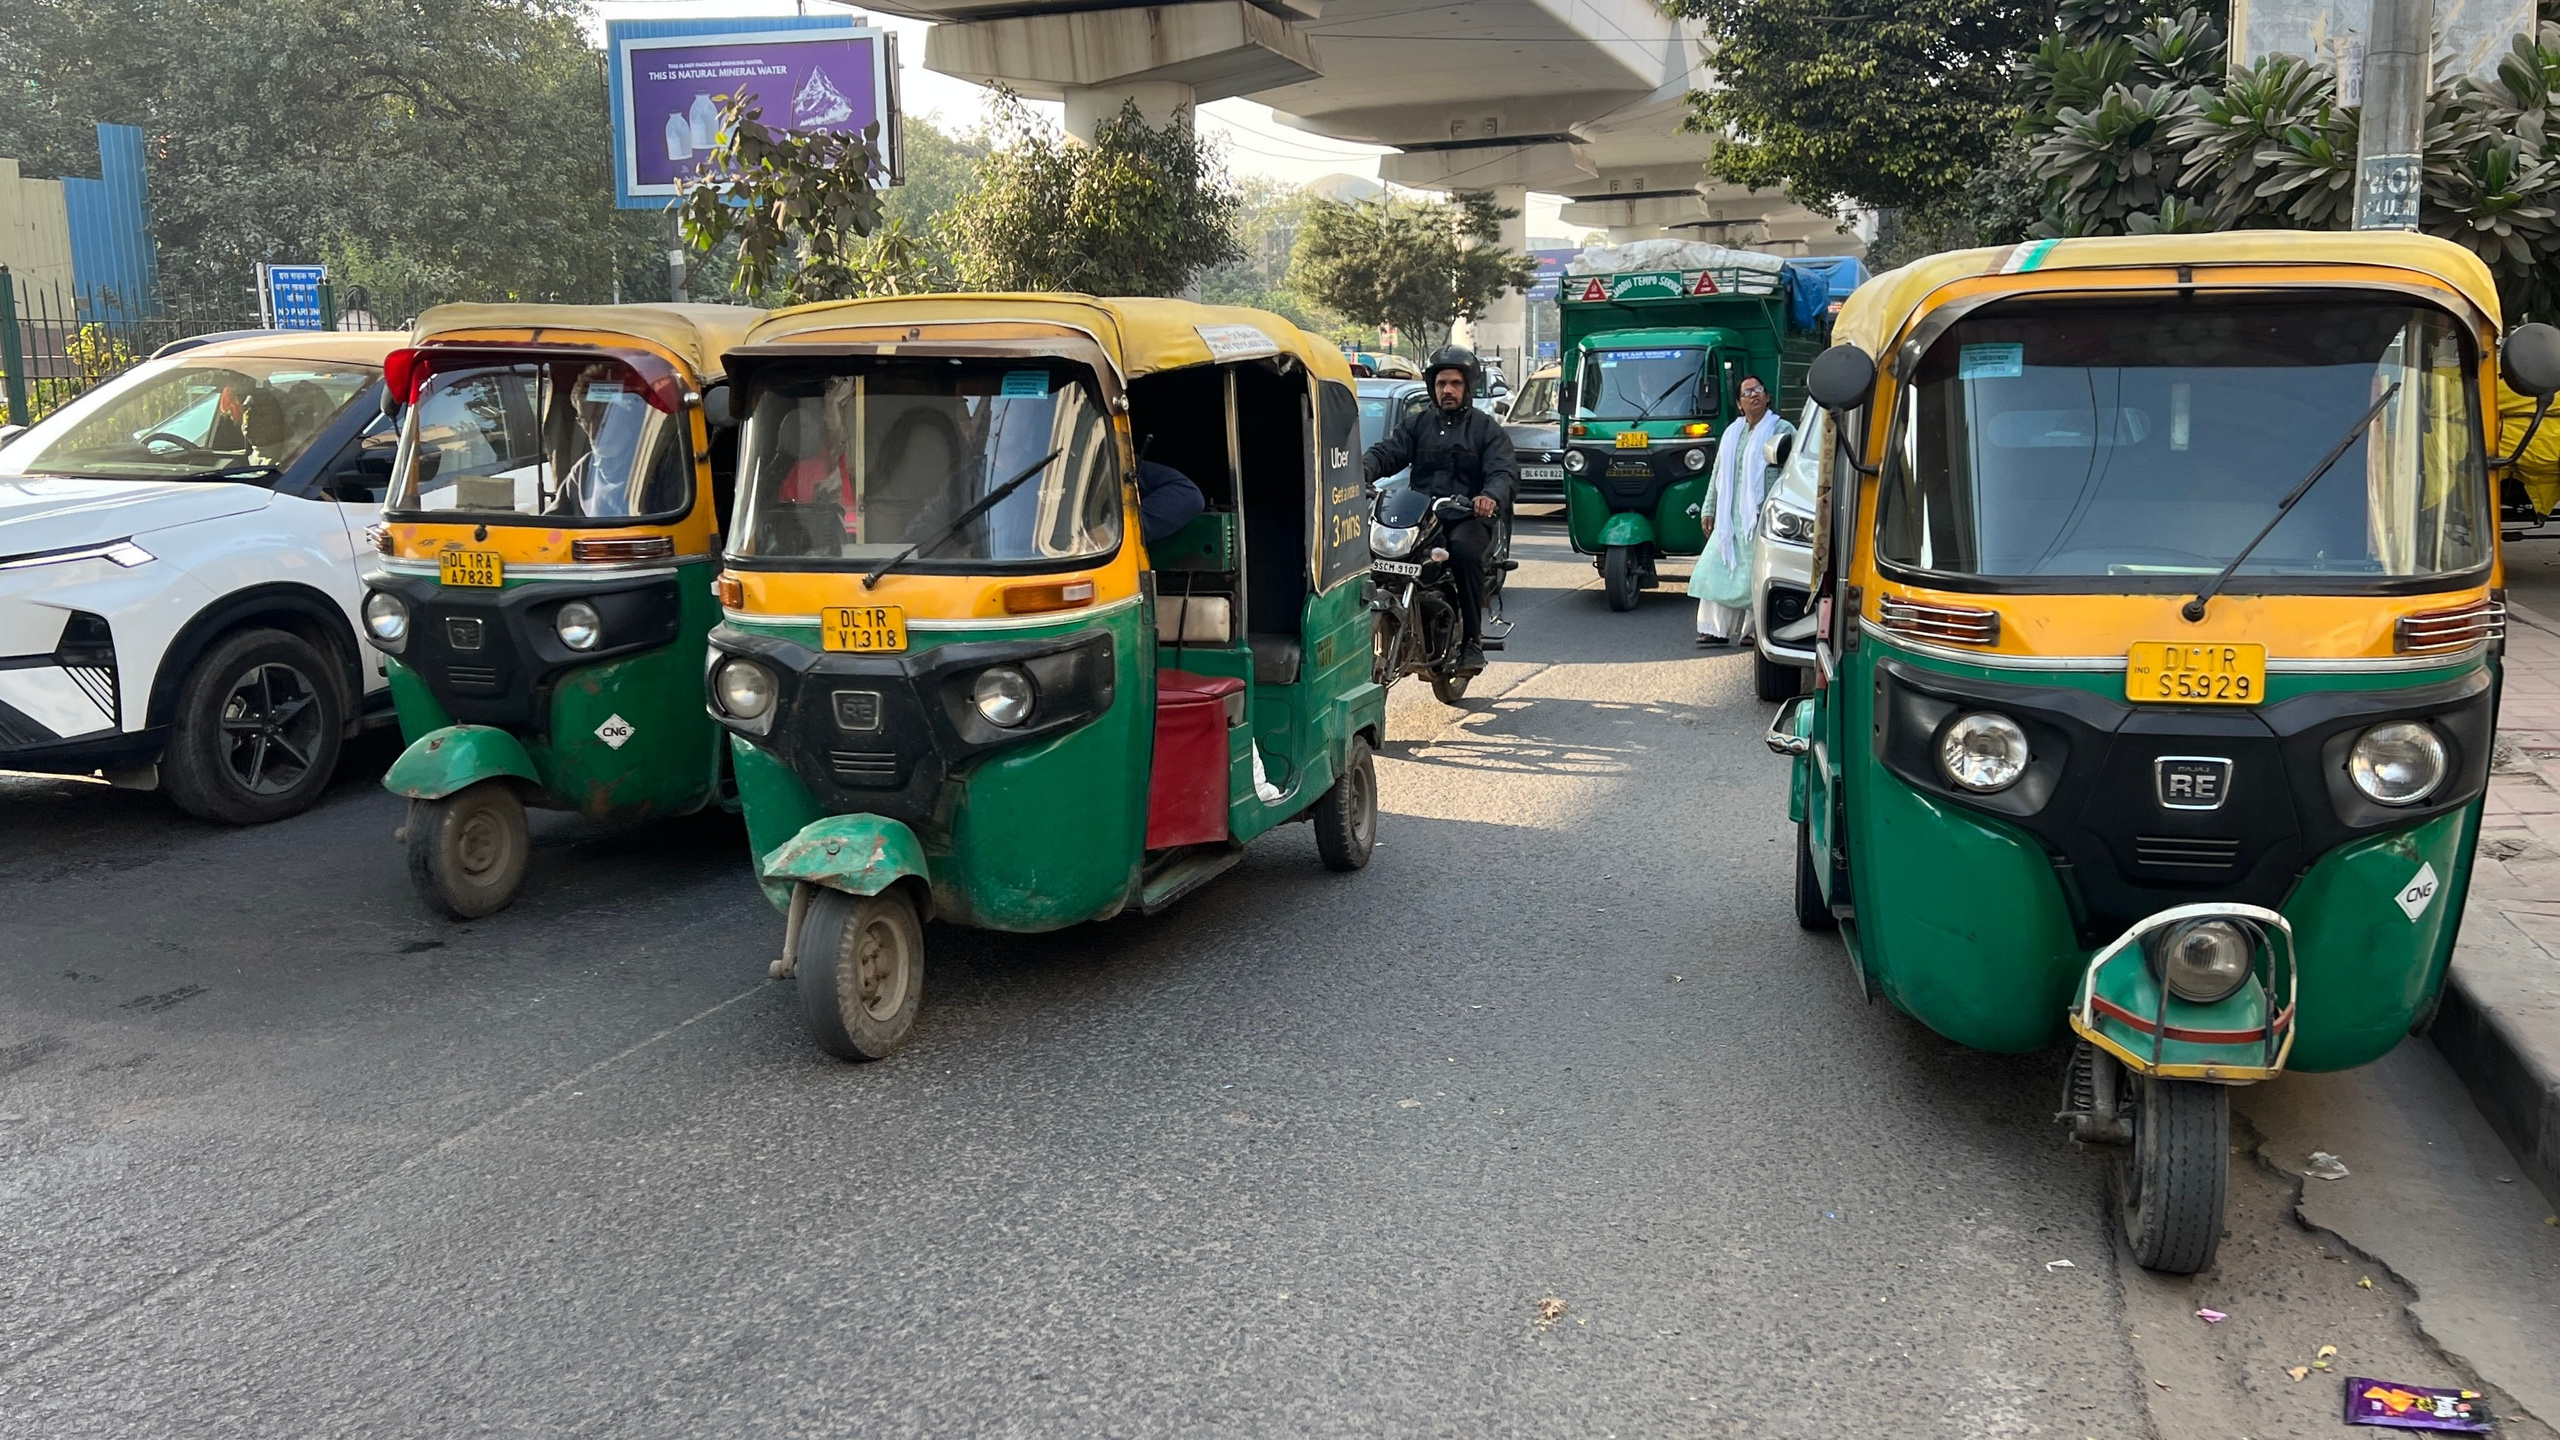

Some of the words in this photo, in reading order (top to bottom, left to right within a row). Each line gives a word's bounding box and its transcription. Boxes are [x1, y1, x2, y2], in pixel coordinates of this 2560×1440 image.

[648, 71, 667, 80] THIS
[668, 71, 677, 80] IS
[678, 68, 717, 79] NATURAL
[719, 67, 756, 77] MINERAL
[758, 65, 787, 75] WATER
[278, 308, 290, 316] NO
[1330, 446, 1350, 469] Uber
[1550, 470, 1563, 478] 822
[1331, 485, 1343, 505] Get
[1332, 513, 1340, 548] 3
[1341, 510, 1362, 543] mins
[450, 552, 492, 569] DL1RA
[451, 569, 494, 585] A7828
[840, 609, 887, 628] DL1R
[839, 629, 897, 649] V1318
[2164, 646, 2237, 672] DL1R
[2134, 666, 2150, 674] IND
[2159, 673, 2250, 699] S5929
[602, 726, 627, 737] CNG
[2169, 774, 2217, 798] RE
[2406, 881, 2433, 903] CNG
